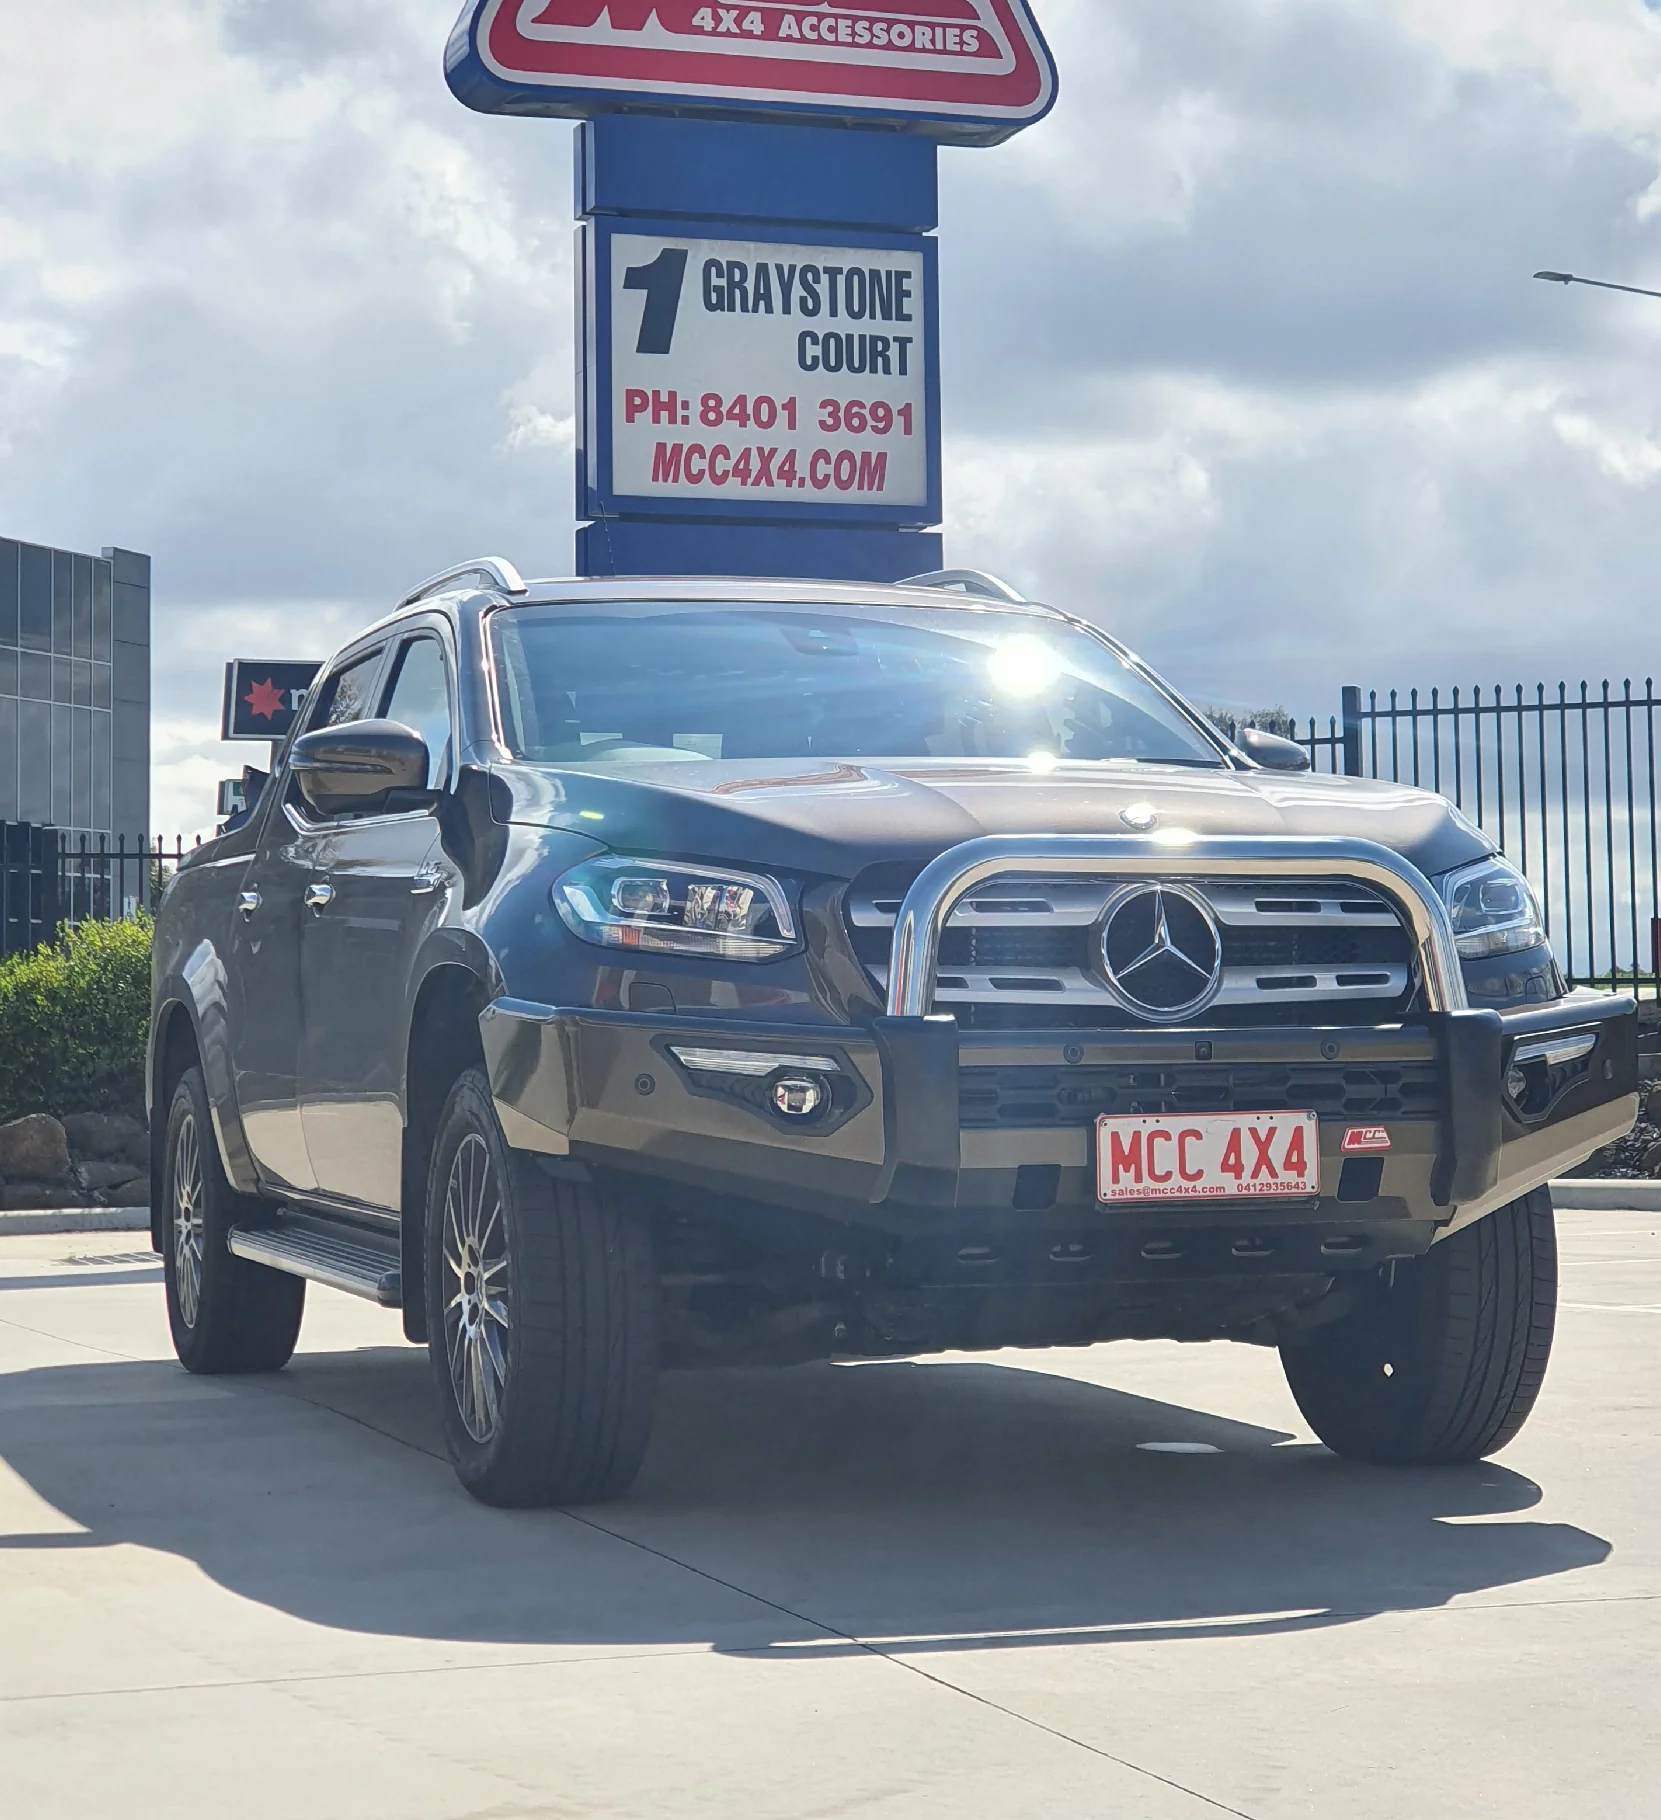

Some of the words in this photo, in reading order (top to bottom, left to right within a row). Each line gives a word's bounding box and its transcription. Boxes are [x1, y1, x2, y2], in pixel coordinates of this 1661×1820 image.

[691, 8, 765, 36] 4X4
[778, 19, 980, 53] ACCESSORIES
[622, 247, 689, 354] 1
[702, 258, 913, 322] GRAYSTONE
[797, 330, 913, 376] COURT
[624, 388, 690, 425] PH:
[699, 393, 797, 430] 8401
[818, 398, 913, 436] 3691
[651, 441, 888, 492] MCC4X4.COM
[1110, 1129, 1205, 1185] MCC
[1220, 1125, 1308, 1180] 4X4
[1110, 1185, 1227, 1197] sales@mcc4x4.com
[1236, 1181, 1308, 1193] 0412935643
